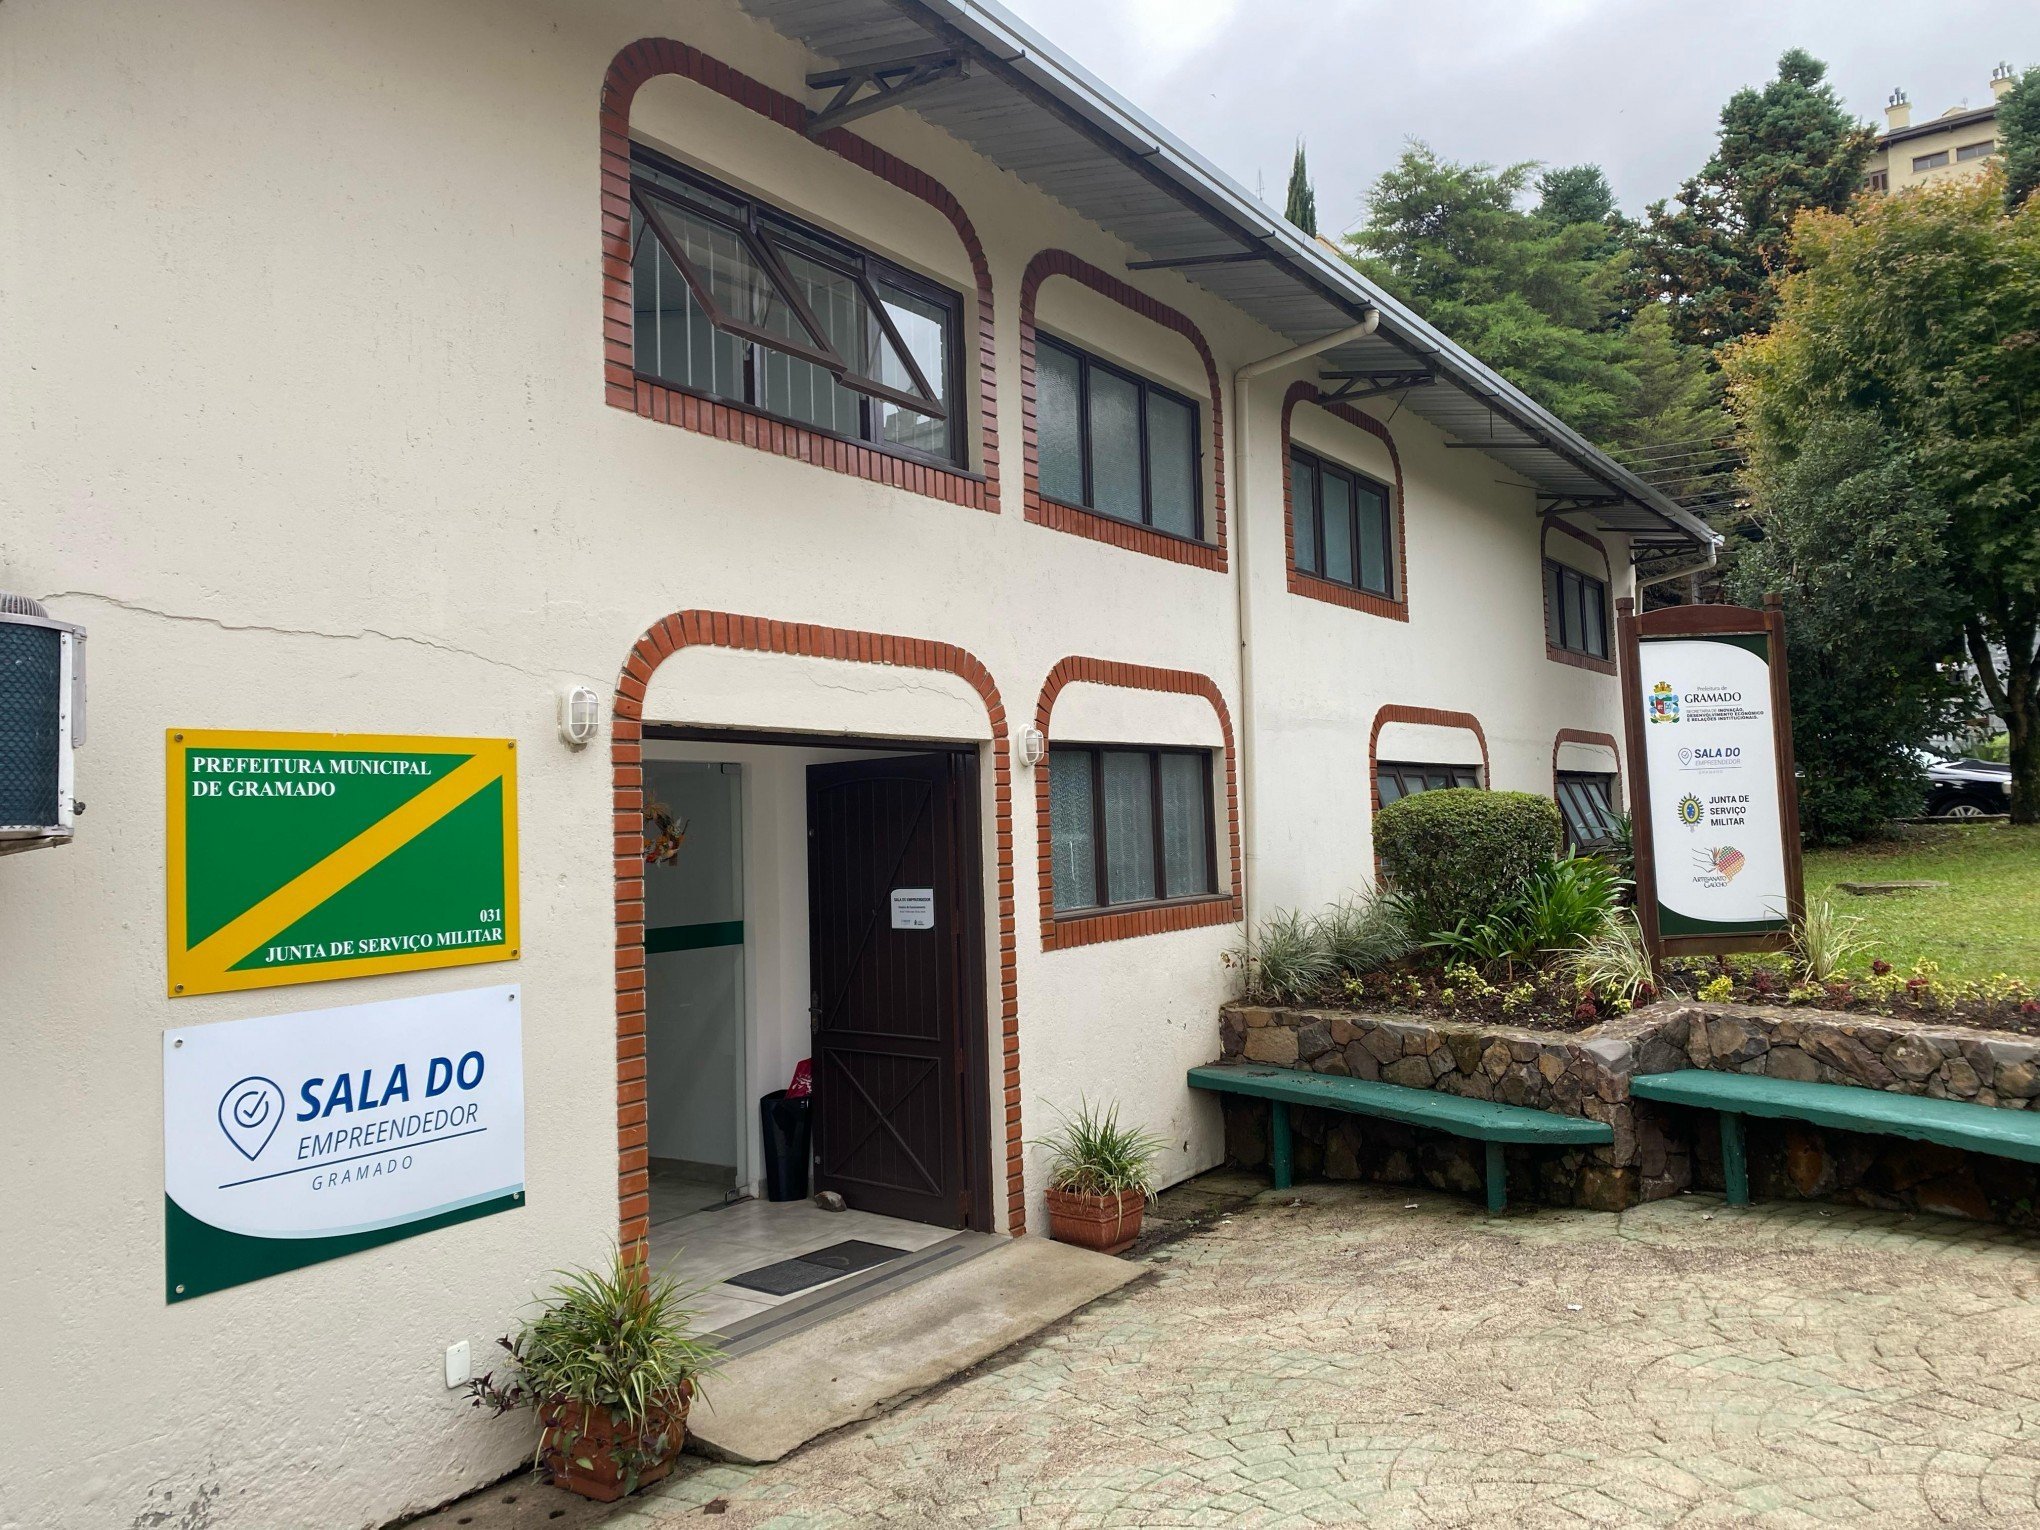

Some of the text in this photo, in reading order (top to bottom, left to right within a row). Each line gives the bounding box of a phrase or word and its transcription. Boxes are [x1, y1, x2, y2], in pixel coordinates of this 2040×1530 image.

[1684, 692, 1742, 703] GRAMADO
[1694, 747, 1741, 758] SALA DO
[192, 757, 431, 776] PREFEITURA MUNICIPAL
[1695, 758, 1741, 766] EMPREENDEDOR
[192, 781, 336, 797] DE GRAMADO
[1709, 795, 1750, 804] JUNTA DE
[1710, 806, 1746, 816] SERVIÇO
[1710, 817, 1745, 826] MILITAR
[480, 909, 501, 922] 031
[265, 928, 503, 963] JUNTA DE SERVIÇO MILITAR
[297, 1050, 485, 1122] SALA DO
[298, 1103, 478, 1160] EMPREENDEDOR
[312, 1155, 413, 1191] GRAMADO
